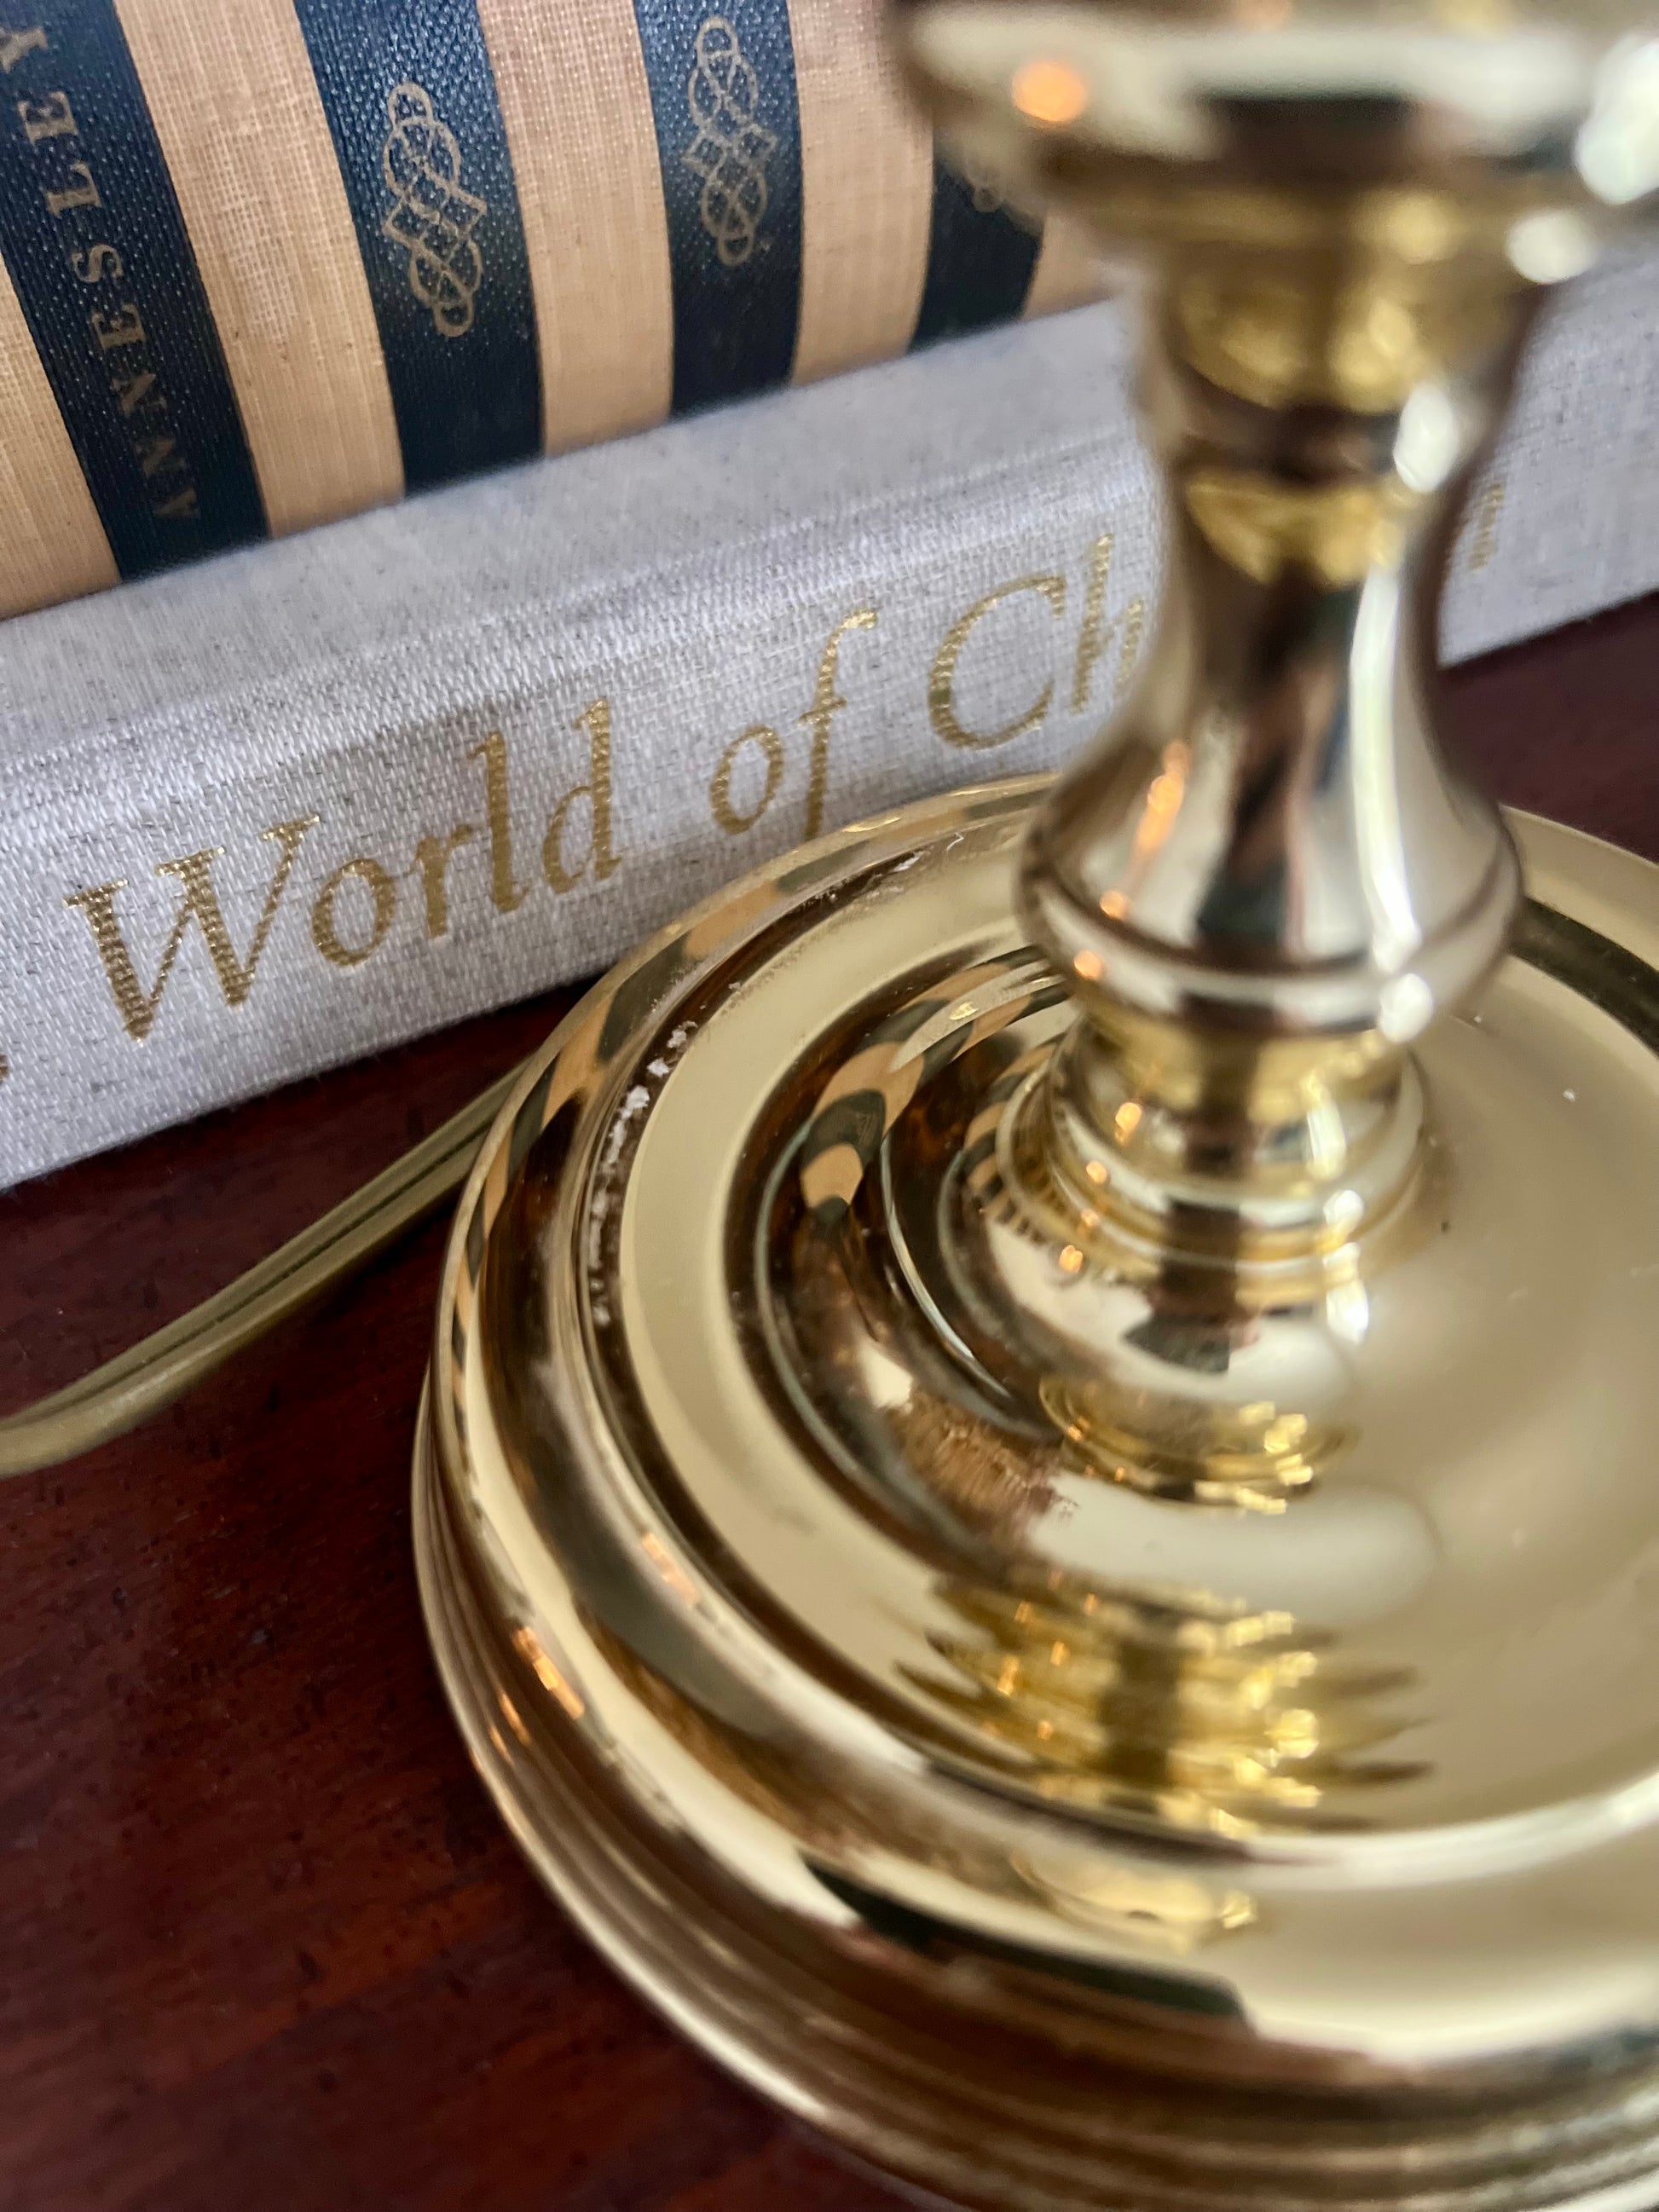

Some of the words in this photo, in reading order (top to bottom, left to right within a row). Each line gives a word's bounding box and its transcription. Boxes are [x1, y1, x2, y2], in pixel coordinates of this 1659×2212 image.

[0, 27, 201, 519] ANNESLEY
[61, 696, 623, 1047] World
[709, 605, 879, 840] of
